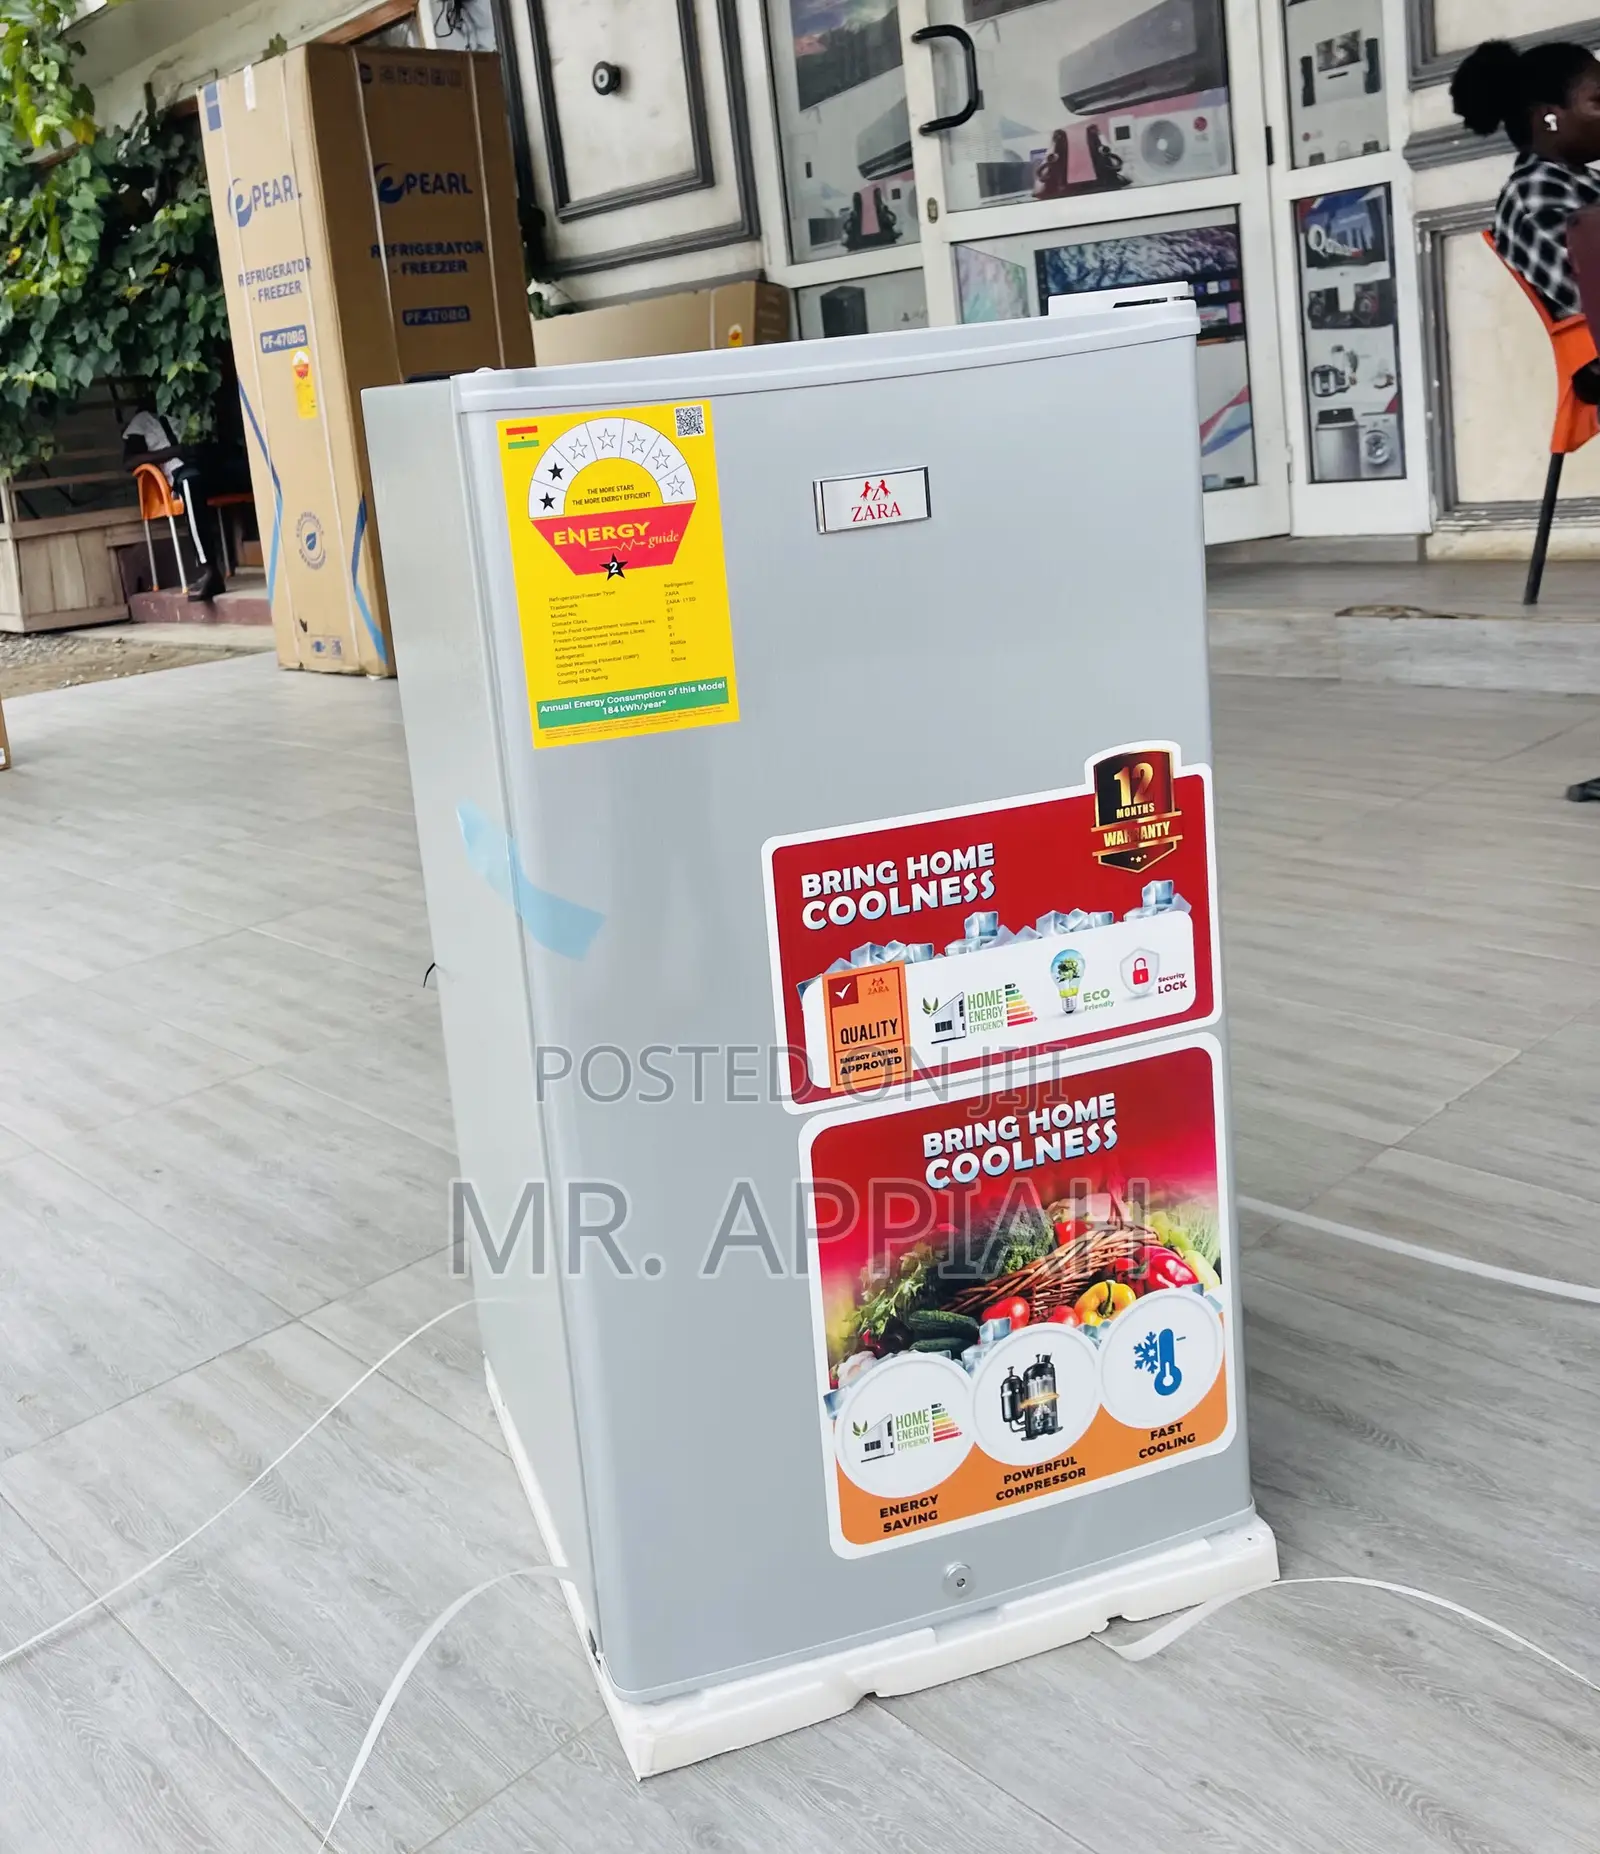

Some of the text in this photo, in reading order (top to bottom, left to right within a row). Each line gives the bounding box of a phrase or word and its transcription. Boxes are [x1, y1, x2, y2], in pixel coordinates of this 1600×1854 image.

[251, 174, 303, 212] PEAR
[405, 172, 474, 196] PEARL
[257, 280, 303, 303] FREEZER
[584, 497, 600, 505] MORE
[601, 495, 623, 503] ENERGY
[624, 492, 651, 500] EFFICIENT
[600, 486, 615, 494] MORE
[616, 484, 635, 492] STARS
[851, 501, 902, 523] ZARA
[553, 521, 651, 549] ENERGY
[648, 530, 680, 549] guide
[609, 561, 619, 574] 2
[540, 681, 726, 714] Annual Energy Consumption of this Model
[602, 706, 619, 716] 184
[1113, 762, 1154, 807] 12
[1115, 802, 1155, 819] MONTHS
[800, 842, 996, 899] BRING HOME
[801, 869, 996, 931] COOLNESS
[1157, 979, 1188, 995] LOCK
[1158, 971, 1186, 984] Security
[967, 987, 1004, 1011] HOME
[1083, 988, 1111, 1004] ECO
[1084, 999, 1115, 1012] Friendly
[967, 1005, 1005, 1024] ENERGY
[840, 1017, 899, 1045] QUALITY
[968, 1018, 1005, 1034] EFFICIENCY
[839, 1046, 899, 1065] ENERGY RATING
[839, 1055, 903, 1076] APPROVED
[922, 1092, 1116, 1159] BRING HOME
[924, 1118, 1119, 1190] COOLNESS
[895, 1408, 930, 1430] HOME
[896, 1424, 931, 1442] ENERGY
[1149, 1421, 1184, 1442] FAST
[897, 1435, 932, 1451] EFFICIENCY
[1137, 1432, 1197, 1459] COOLING
[1003, 1455, 1078, 1485] POWERFUL
[995, 1466, 1087, 1502] COMPRESSOR
[879, 1493, 939, 1519] ENERGY
[882, 1510, 939, 1533] SAVING
